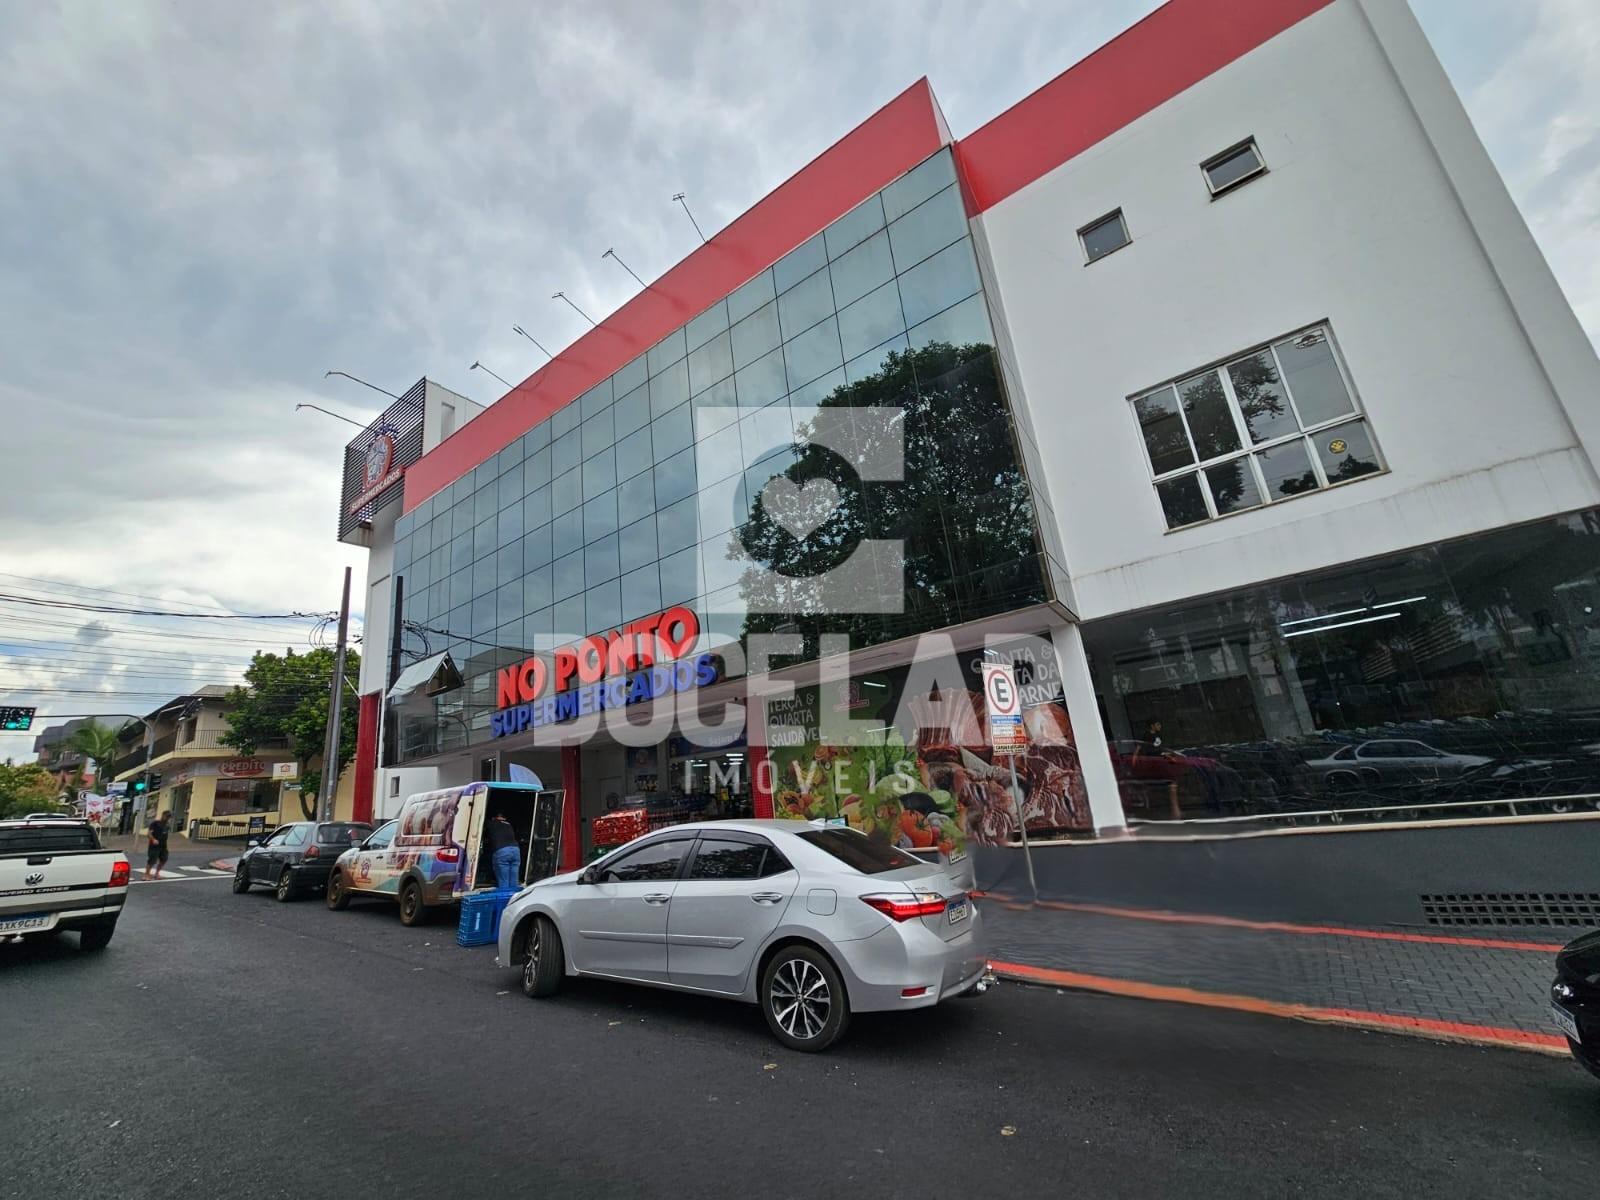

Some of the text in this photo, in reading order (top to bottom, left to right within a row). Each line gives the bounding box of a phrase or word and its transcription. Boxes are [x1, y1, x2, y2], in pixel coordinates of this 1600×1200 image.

[497, 606, 700, 709] NO PONTO
[489, 652, 719, 739] SUPERMERCADOS
[769, 709, 815, 730] QUARTA
[1017, 680, 1064, 705] ARNE
